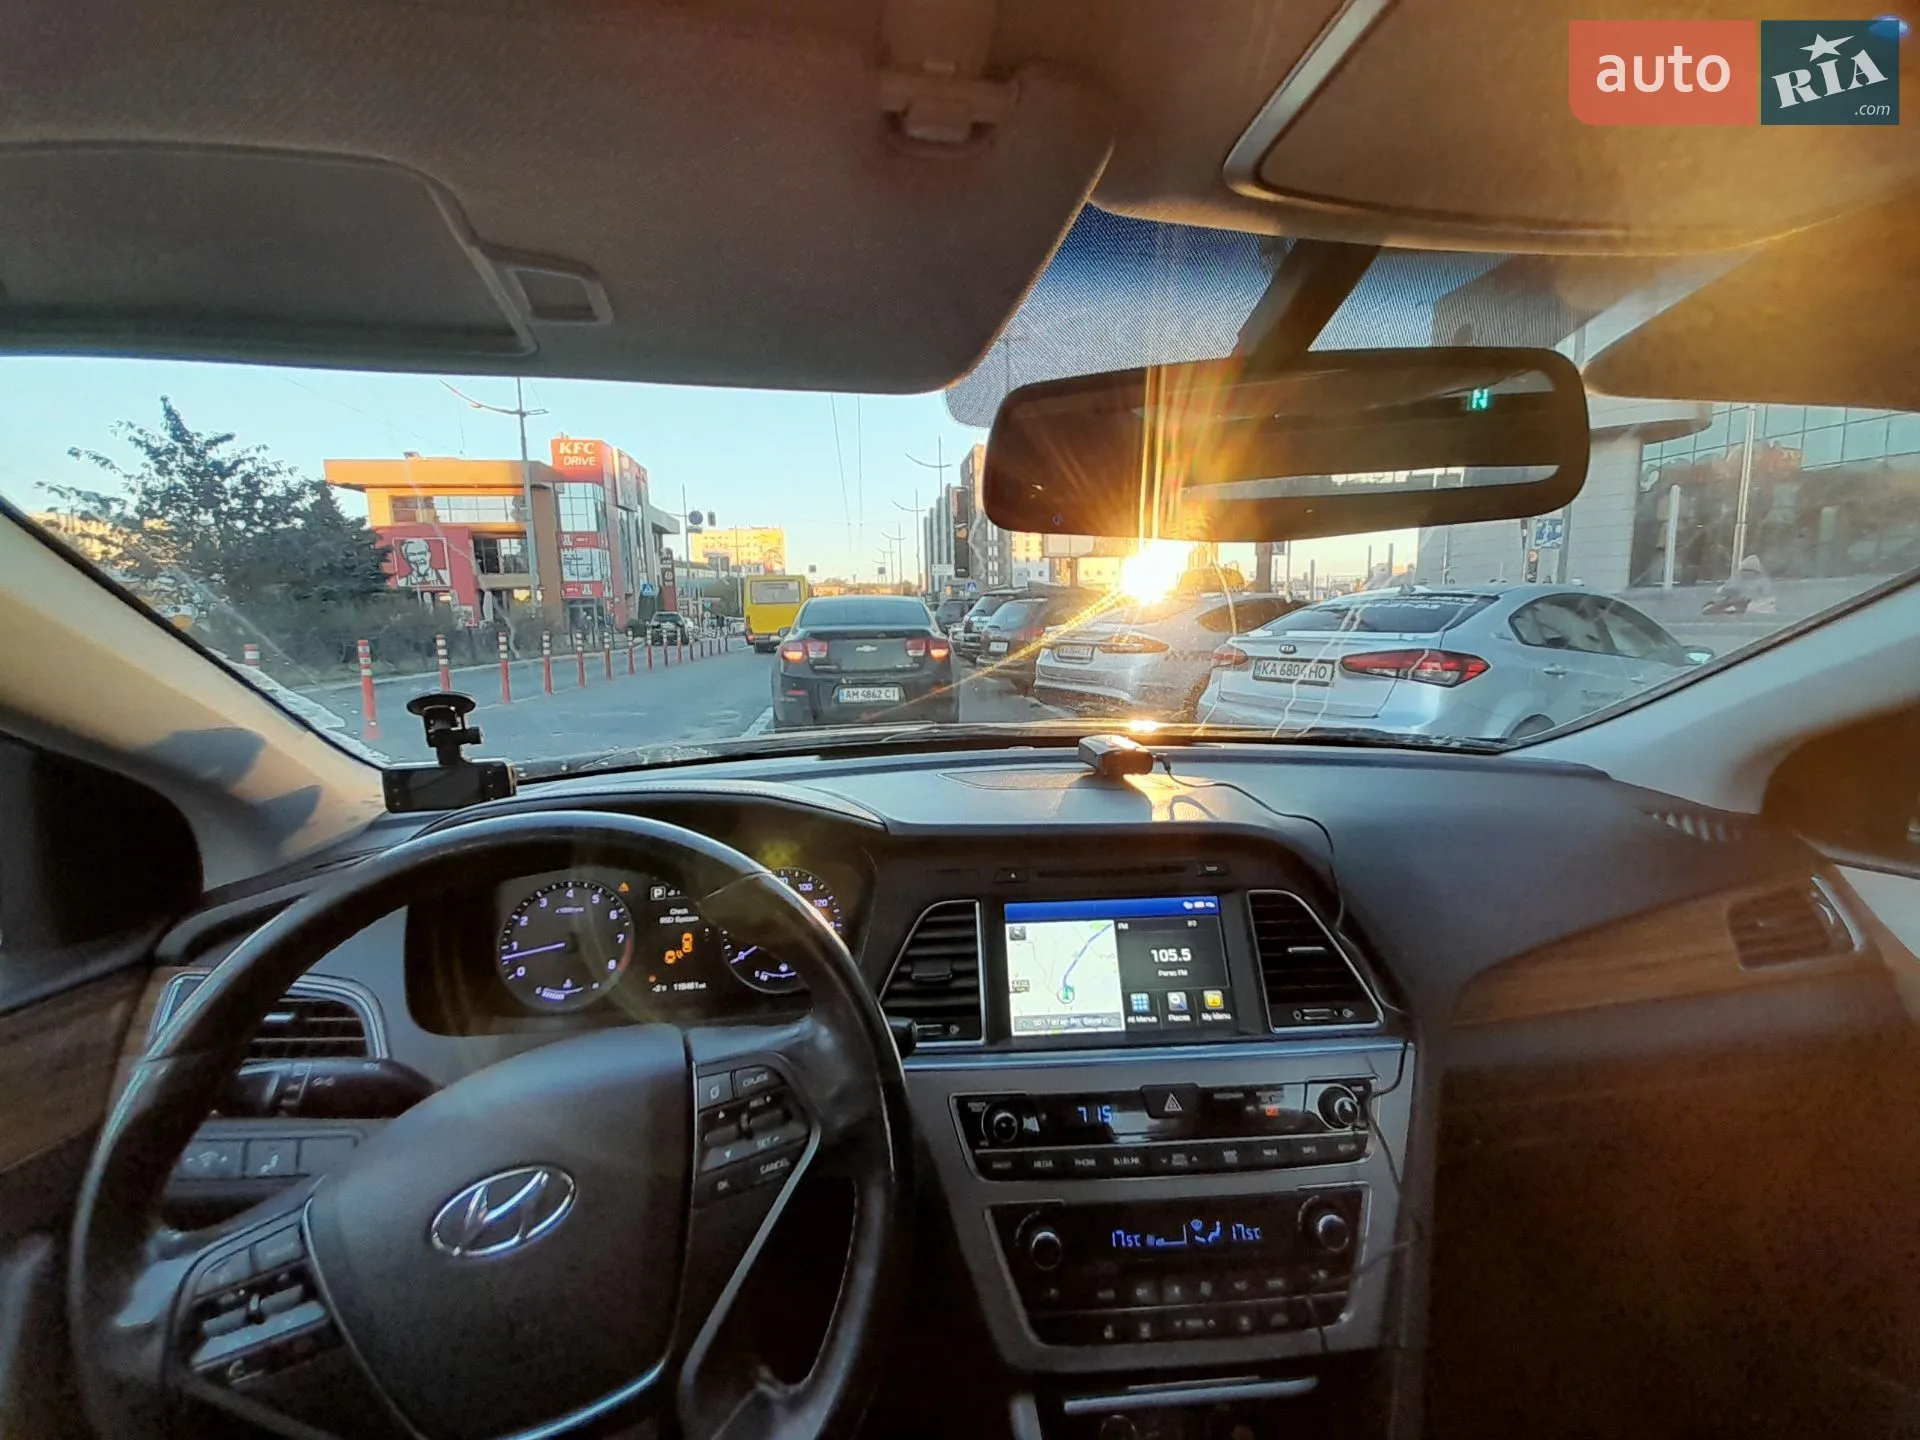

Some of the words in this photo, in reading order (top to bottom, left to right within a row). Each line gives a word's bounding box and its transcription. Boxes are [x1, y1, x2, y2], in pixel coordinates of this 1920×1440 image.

[559, 441, 595, 455] KFC
[563, 456, 597, 466] DRIVE
[1261, 662, 1277, 675] KA
[1308, 665, 1327, 679] HO
[845, 690, 860, 699] AM
[798, 883, 813, 891] 100
[566, 889, 574, 898] 4
[592, 894, 600, 904] 5
[814, 899, 828, 907] 120
[609, 910, 618, 920] 6
[520, 916, 529, 926] 2
[617, 933, 625, 943] 7
[1150, 948, 1192, 962] 105.5
[608, 959, 617, 970] 8
[517, 966, 525, 977] 0
